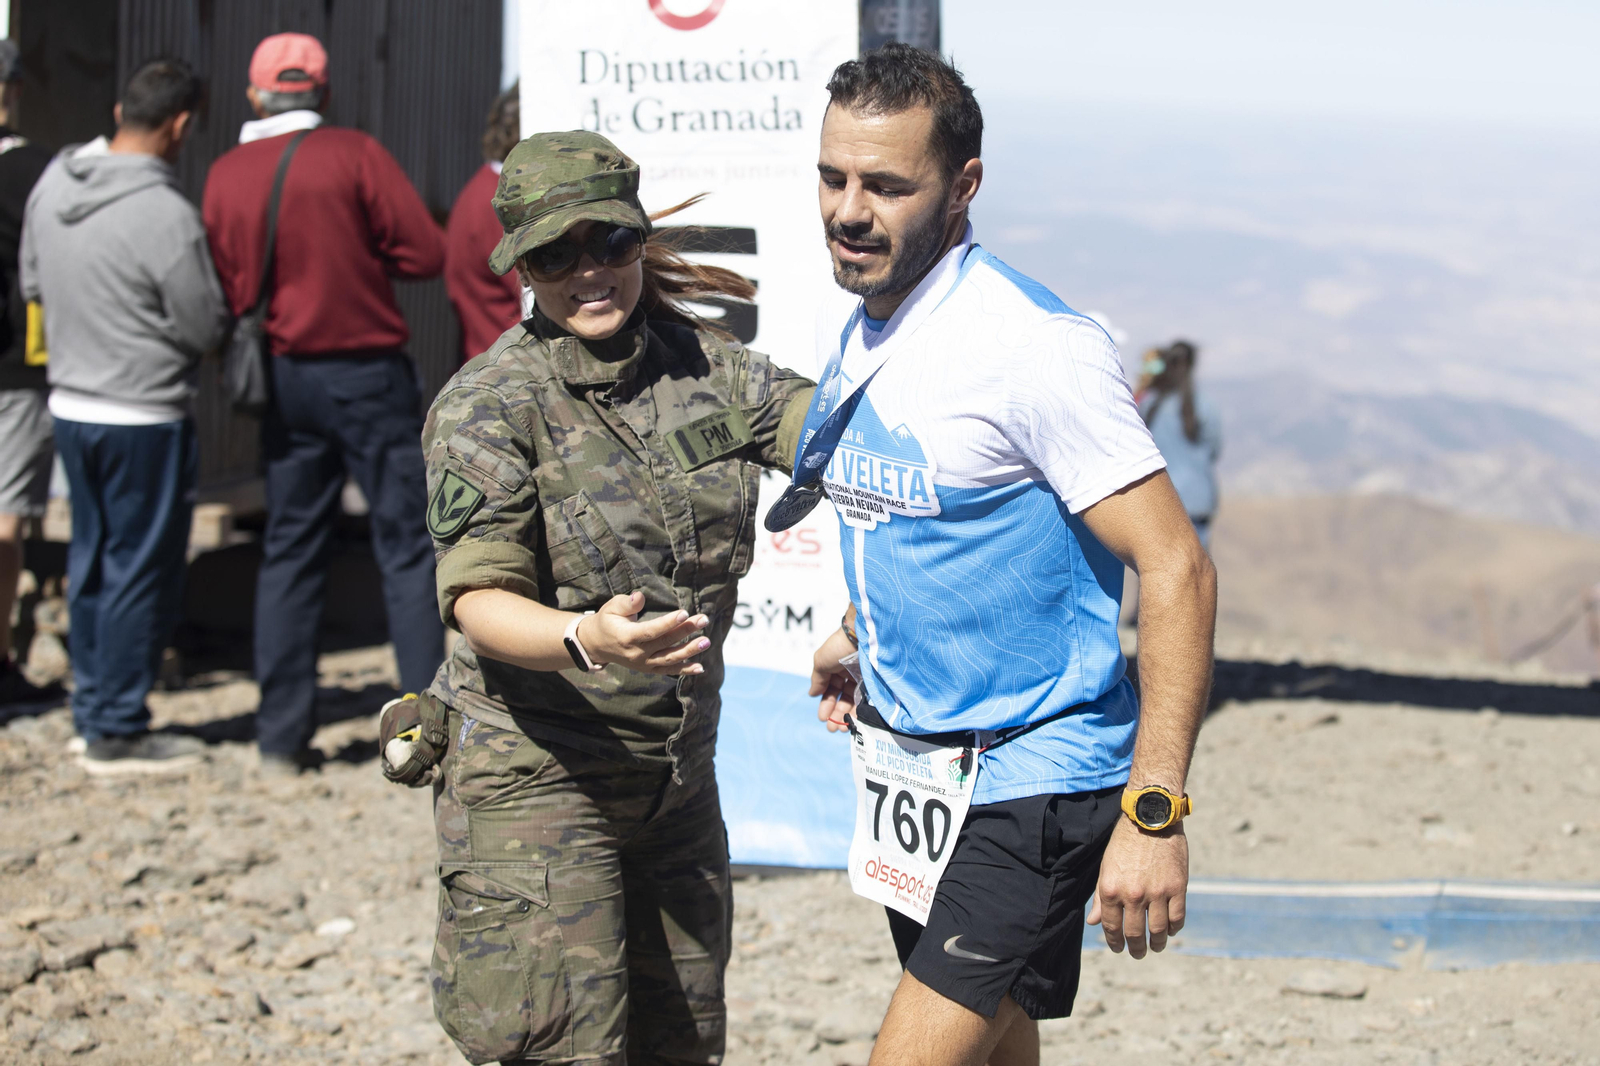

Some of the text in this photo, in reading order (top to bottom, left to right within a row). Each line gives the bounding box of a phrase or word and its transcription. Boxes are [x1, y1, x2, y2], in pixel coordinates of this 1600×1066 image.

[578, 49, 800, 93] Diputación
[580, 95, 803, 134] de Granada
[700, 422, 734, 448] PM
[855, 431, 865, 445] AL
[842, 450, 930, 503] VELETA
[832, 492, 885, 515] SIERRA NEVADA
[853, 488, 886, 504] MOUNTAIN
[886, 498, 907, 510] RACE
[846, 508, 872, 522] GRANADA
[876, 752, 886, 767] AL
[887, 756, 905, 772] PICO
[907, 762, 933, 780] VELETA
[865, 765, 891, 780] MANUEL
[891, 773, 909, 786] LOPEZ
[909, 779, 947, 796] FERNANDEZ
[865, 778, 951, 863] 760
